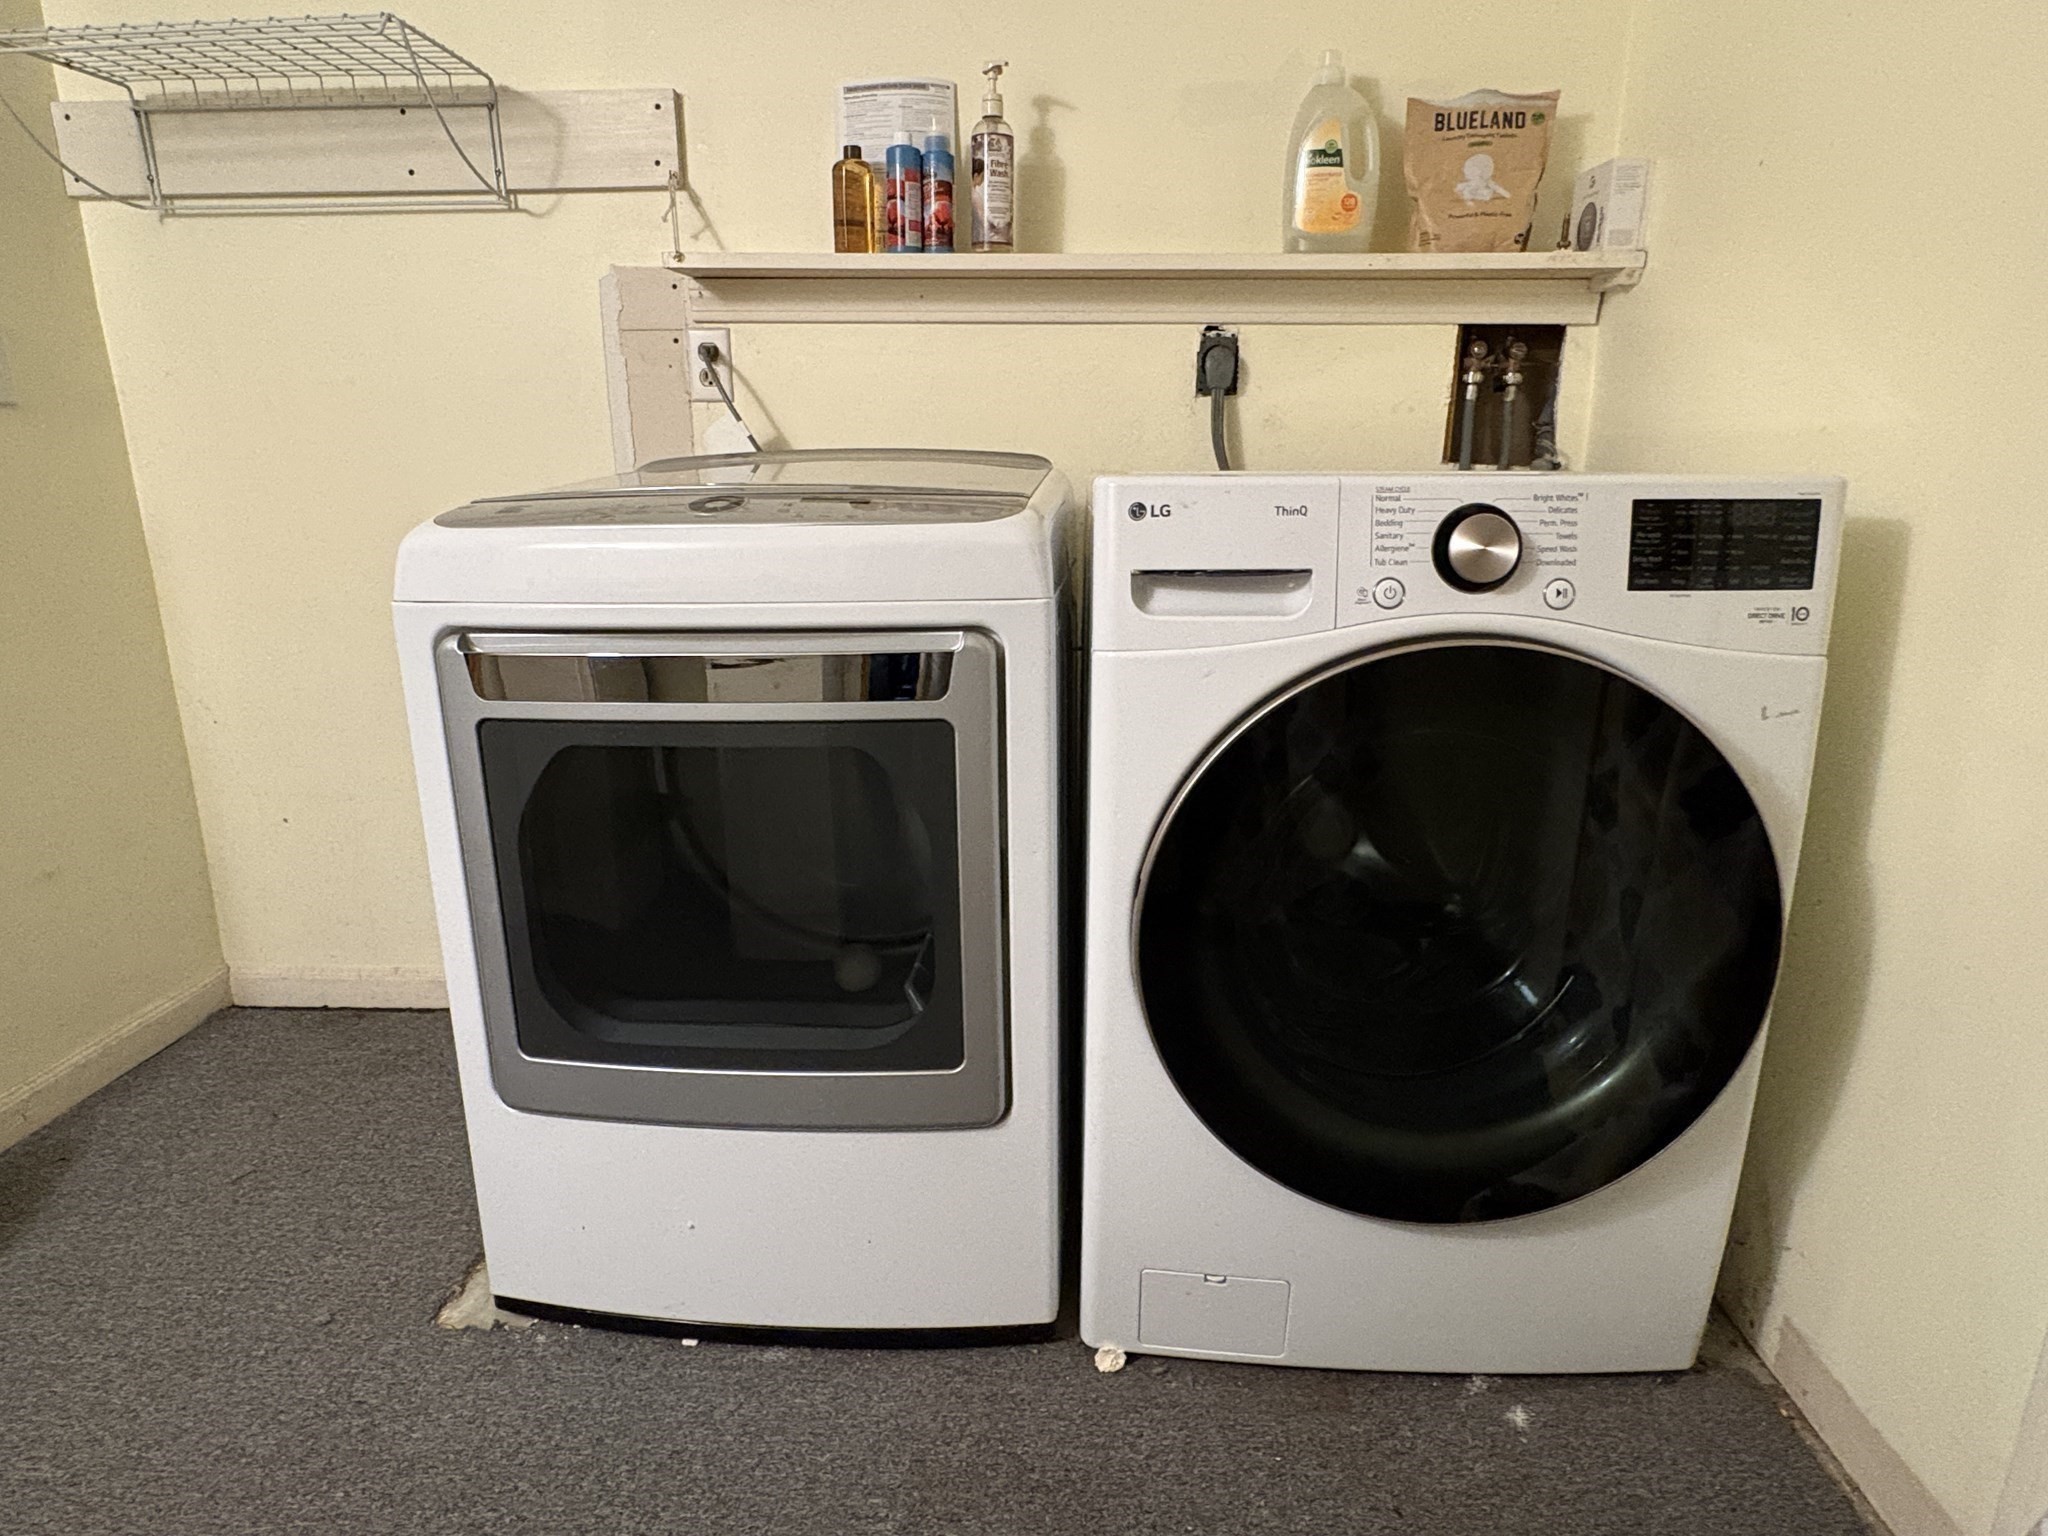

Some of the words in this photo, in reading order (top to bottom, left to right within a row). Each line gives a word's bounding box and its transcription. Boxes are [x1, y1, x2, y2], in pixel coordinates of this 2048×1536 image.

[1434, 110, 1526, 132] BLUELAND
[989, 169, 1009, 178] Wash
[1533, 493, 1554, 503] Bright
[1150, 504, 1171, 518] LG
[1274, 505, 1308, 517] ThinQ
[1375, 506, 1397, 515] Heavy
[1398, 506, 1415, 515] Duty
[1547, 506, 1578, 514] Delicates
[1375, 519, 1403, 529] Bedding
[1539, 519, 1558, 527] Perm.
[1560, 519, 1578, 527] Press
[1375, 532, 1403, 540] Sanitary
[1556, 532, 1578, 540] Towels
[1536, 545, 1558, 554] Speed
[1374, 558, 1387, 566] Tub
[1388, 558, 1408, 566] Clean
[1536, 558, 1576, 566] Downloaded
